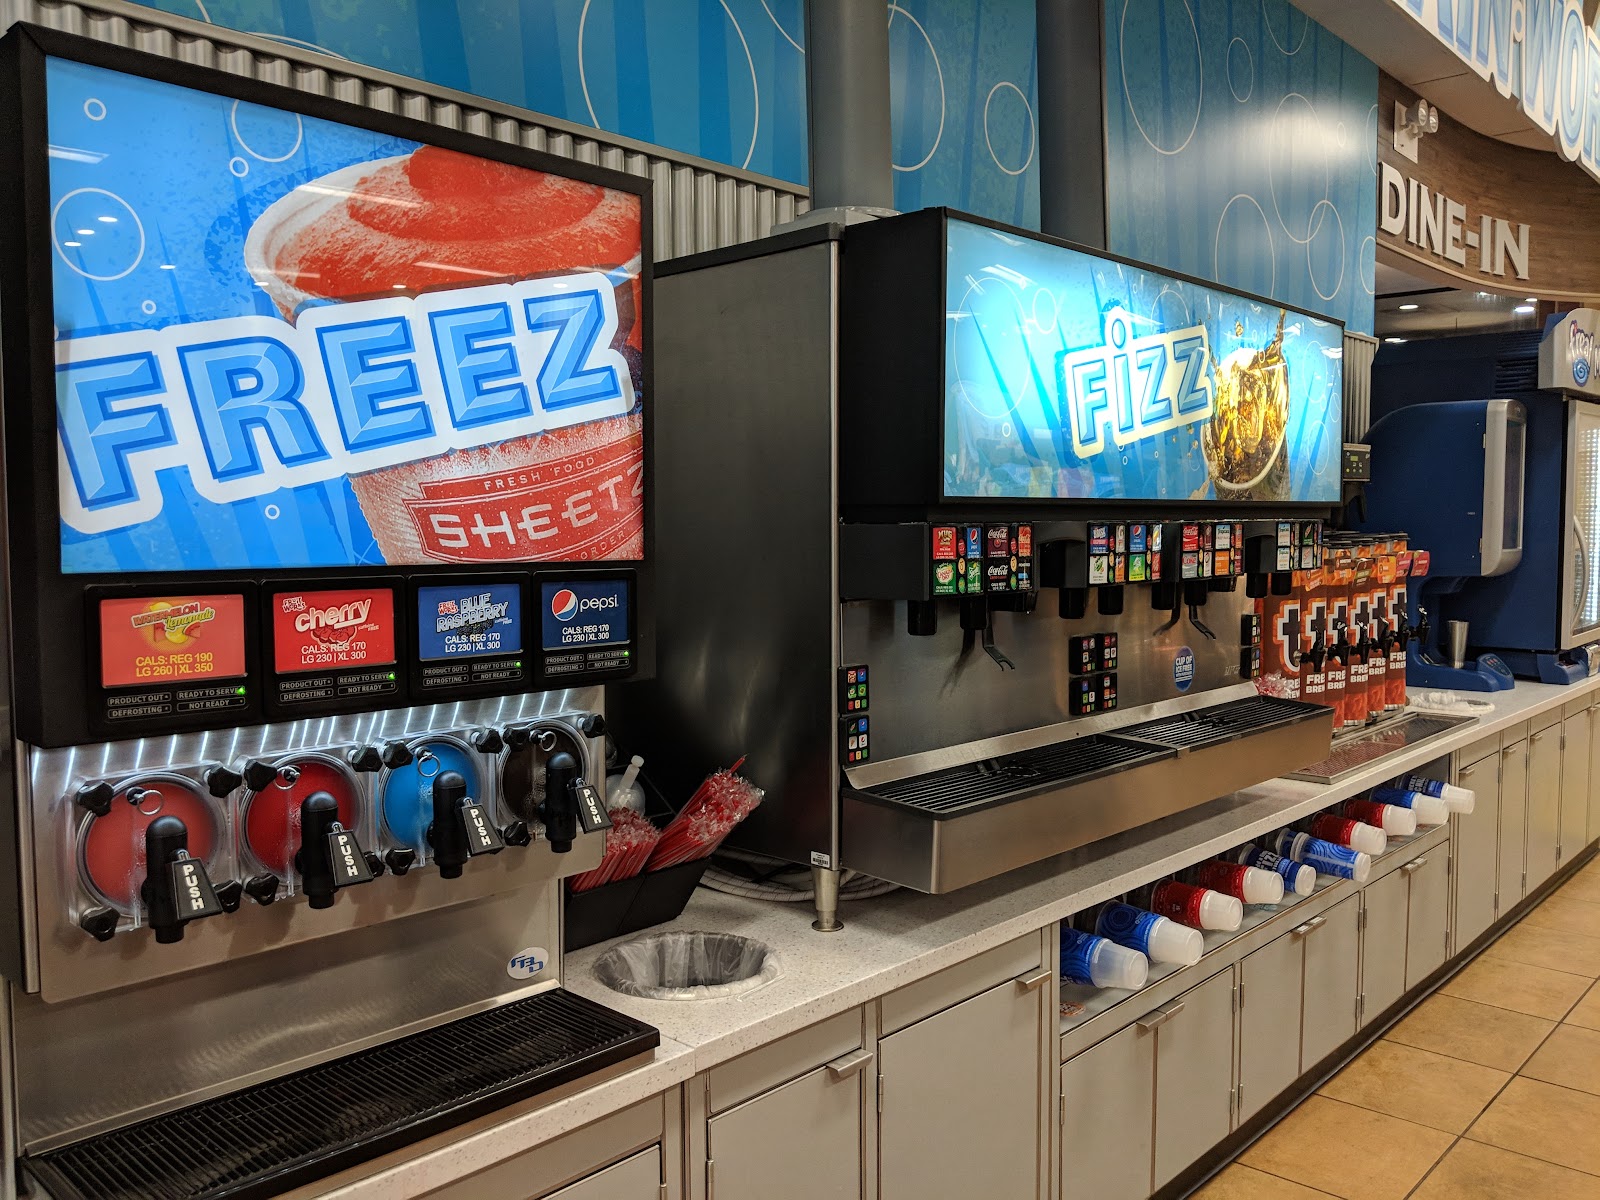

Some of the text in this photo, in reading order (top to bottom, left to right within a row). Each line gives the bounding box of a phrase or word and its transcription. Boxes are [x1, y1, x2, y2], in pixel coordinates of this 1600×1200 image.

[1379, 161, 1531, 281] DINE-IN
[56, 287, 622, 515] FREEZ
[483, 457, 595, 490] FRESH FOOD
[580, 530, 625, 559] ORDER
[460, 593, 492, 612] BLUE
[580, 594, 618, 612] pepsi
[132, 604, 198, 626] WATERMELON
[164, 609, 214, 630] Lemonade
[295, 599, 371, 632] cherry
[437, 602, 509, 632] RASPBERRY
[562, 627, 582, 635] CALS:
[583, 625, 597, 633] REG
[445, 635, 469, 643] CALS:
[470, 634, 486, 642] REG
[562, 635, 572, 643] LG
[301, 641, 366, 654] CALS: REG 170
[445, 645, 456, 653] LG
[486, 641, 500, 649] 300
[136, 652, 213, 667] CALS: REG 190
[301, 655, 314, 664] LG
[316, 654, 332, 662] 230
[338, 652, 349, 660] XL
[350, 651, 366, 659] 300
[136, 667, 151, 677] LG
[153, 666, 172, 675] 260
[179, 664, 192, 674] XL
[194, 663, 213, 672] 350
[281, 681, 312, 689] PRODUCT
[426, 676, 462, 684] DEFROSTING
[110, 694, 164, 705] PRODUCT OUT
[179, 691, 203, 699] READY
[283, 690, 326, 699] DEFROSTING
[112, 707, 163, 717] DEFROSTING
[189, 700, 230, 709] NOT READY
[583, 788, 602, 824] PUSH
[470, 808, 491, 846] PUSH
[337, 835, 358, 876] PUSH
[182, 864, 205, 910] PUSH
